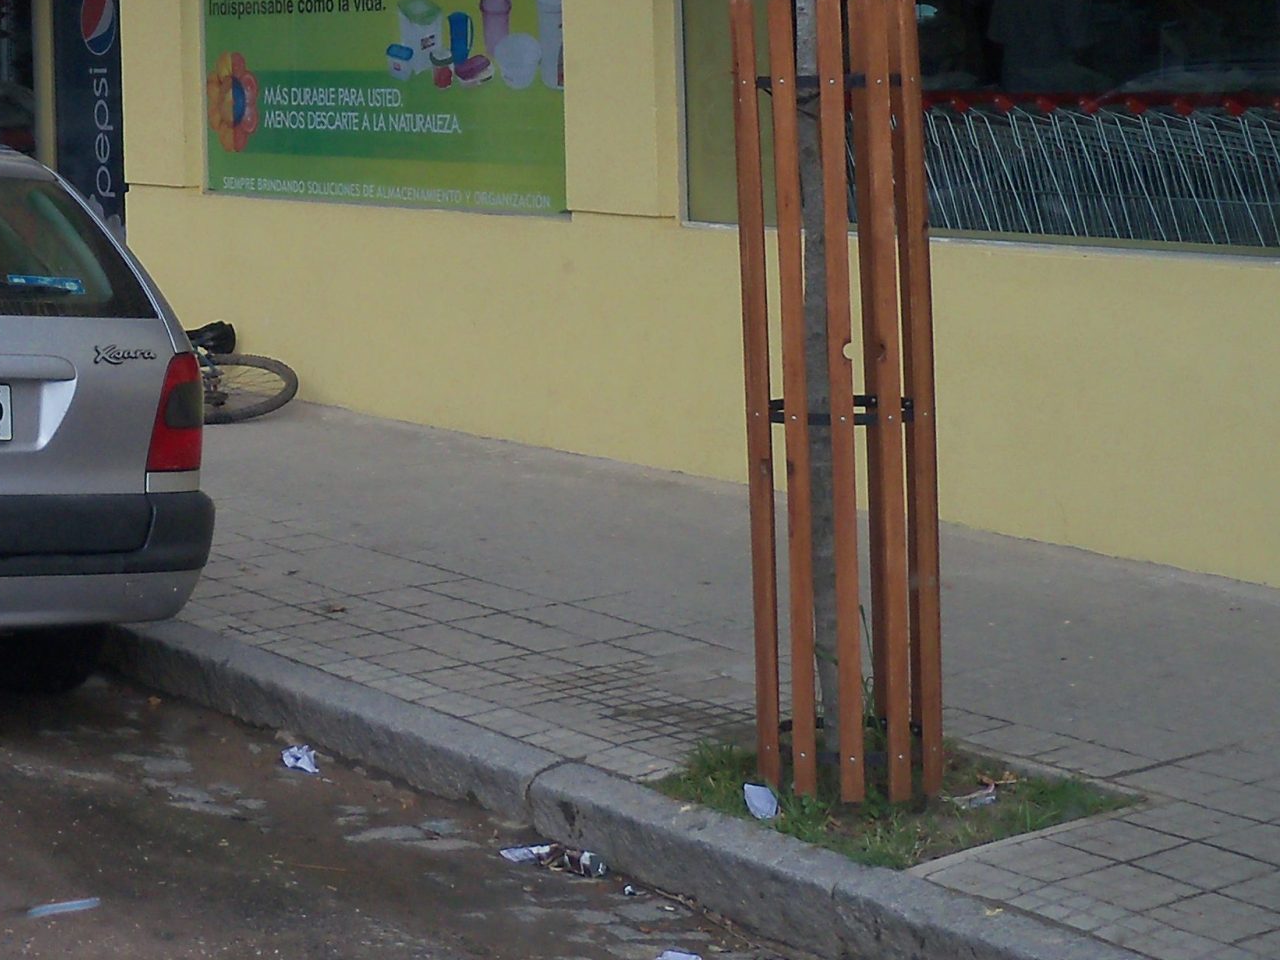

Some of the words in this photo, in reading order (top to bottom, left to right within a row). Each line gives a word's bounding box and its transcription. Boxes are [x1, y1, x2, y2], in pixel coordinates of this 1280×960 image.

[264, 85, 289, 105] MÁS
[291, 87, 335, 106] DURABLE
[338, 88, 365, 106] PARA
[368, 89, 403, 107] USTED.
[89, 66, 115, 198] pepsi
[264, 111, 305, 129] MENOS
[307, 112, 359, 131] DESCARTE
[361, 113, 370, 131] A
[373, 114, 386, 132] LA
[389, 114, 462, 134] NATURALEZA.
[223, 176, 255, 190] SIEMPRE
[257, 178, 304, 193] BRINDANDO
[307, 181, 361, 197] SOLUCIONES
[363, 184, 374, 197] DE
[377, 185, 461, 203] ALMACENAMIENTO
[465, 192, 471, 203] Y
